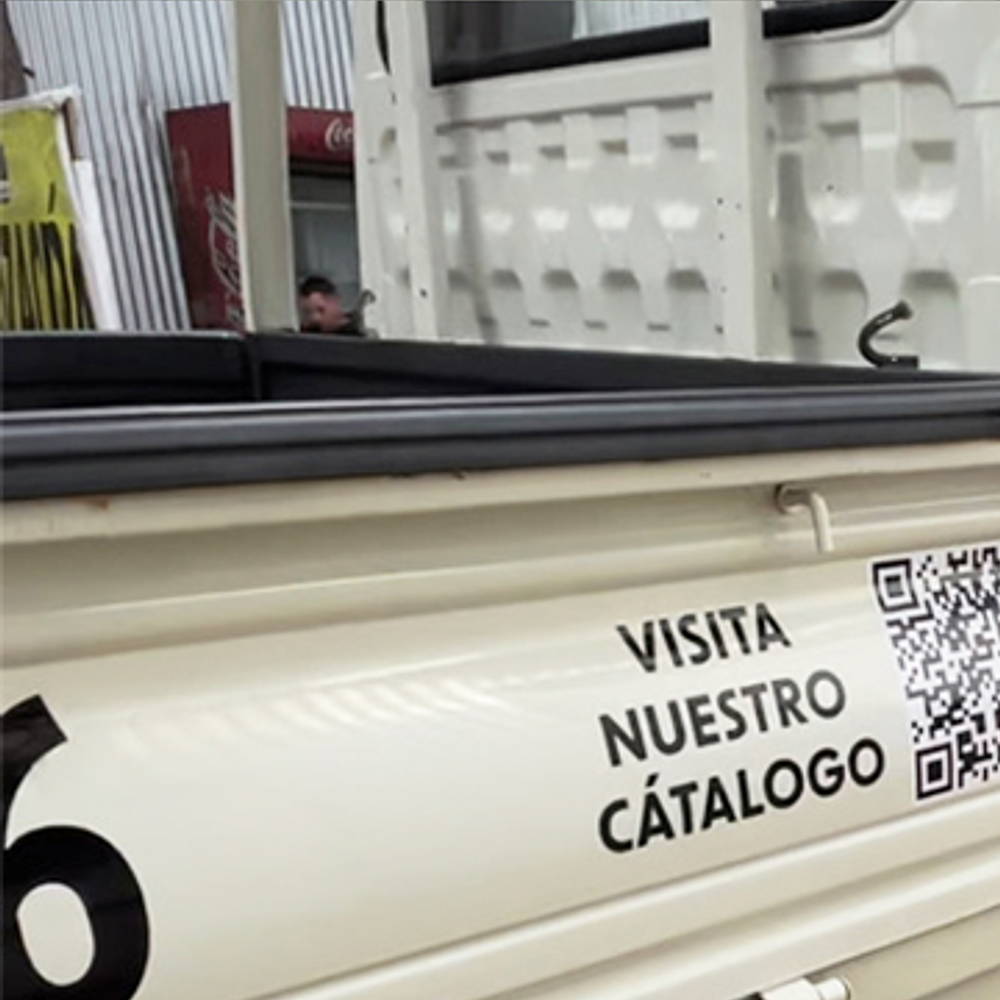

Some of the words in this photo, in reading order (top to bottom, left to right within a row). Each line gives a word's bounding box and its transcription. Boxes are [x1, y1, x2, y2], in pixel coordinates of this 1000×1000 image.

[616, 602, 792, 673] VISITA
[598, 669, 846, 767] NUESTRO
[598, 737, 885, 854] CÁTALOGO
